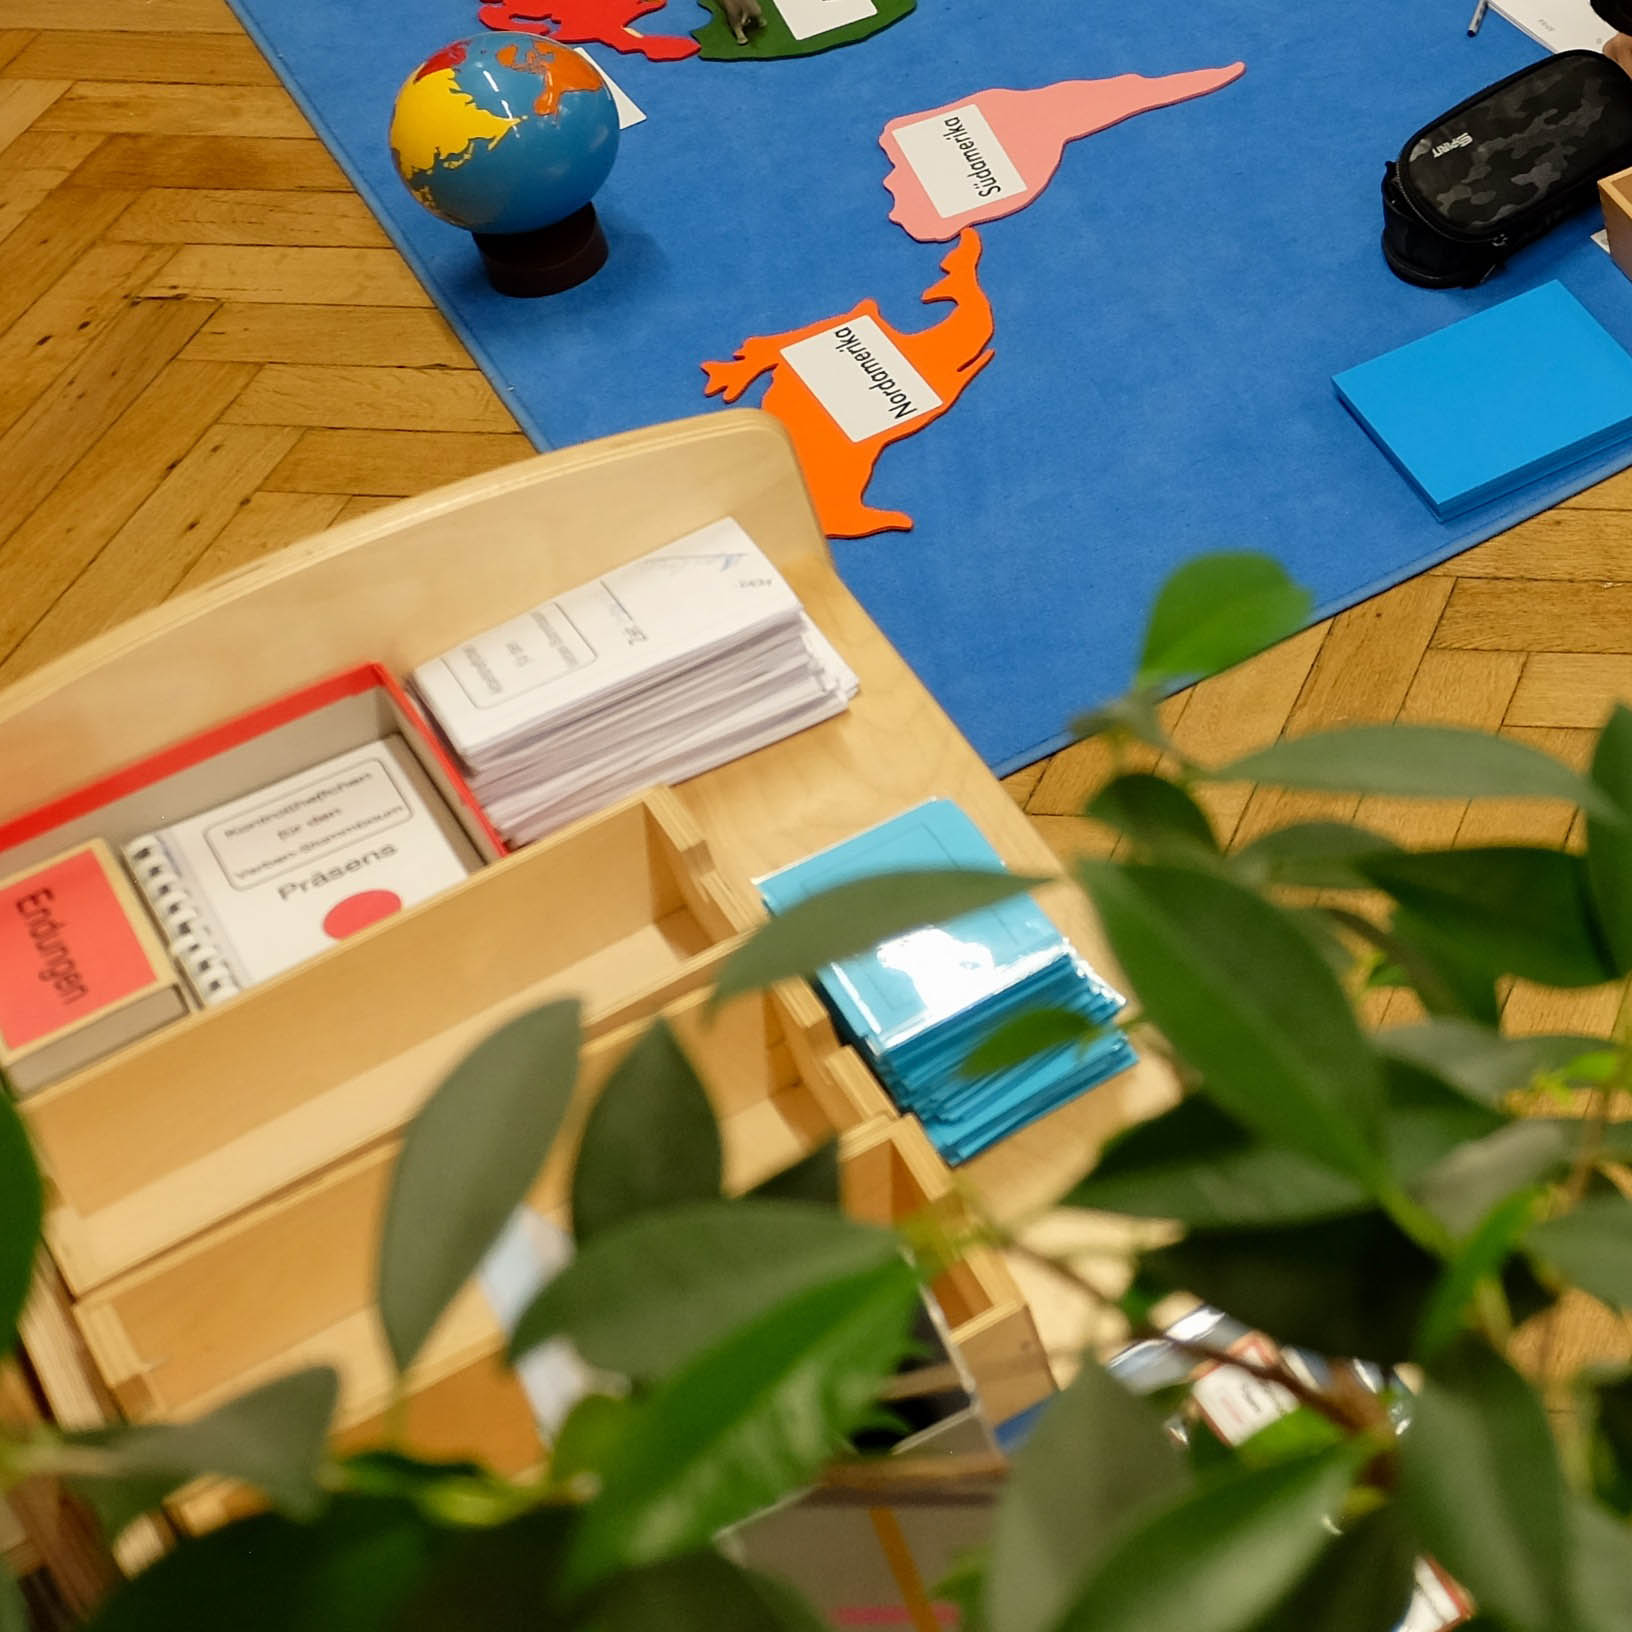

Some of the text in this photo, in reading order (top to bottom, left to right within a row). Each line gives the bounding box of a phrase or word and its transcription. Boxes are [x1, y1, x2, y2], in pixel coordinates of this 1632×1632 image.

[943, 115, 1002, 199] Südamerika
[834, 325, 918, 420] Nordamerika
[275, 839, 400, 903] Präsens
[14, 885, 90, 1005] Endungen
